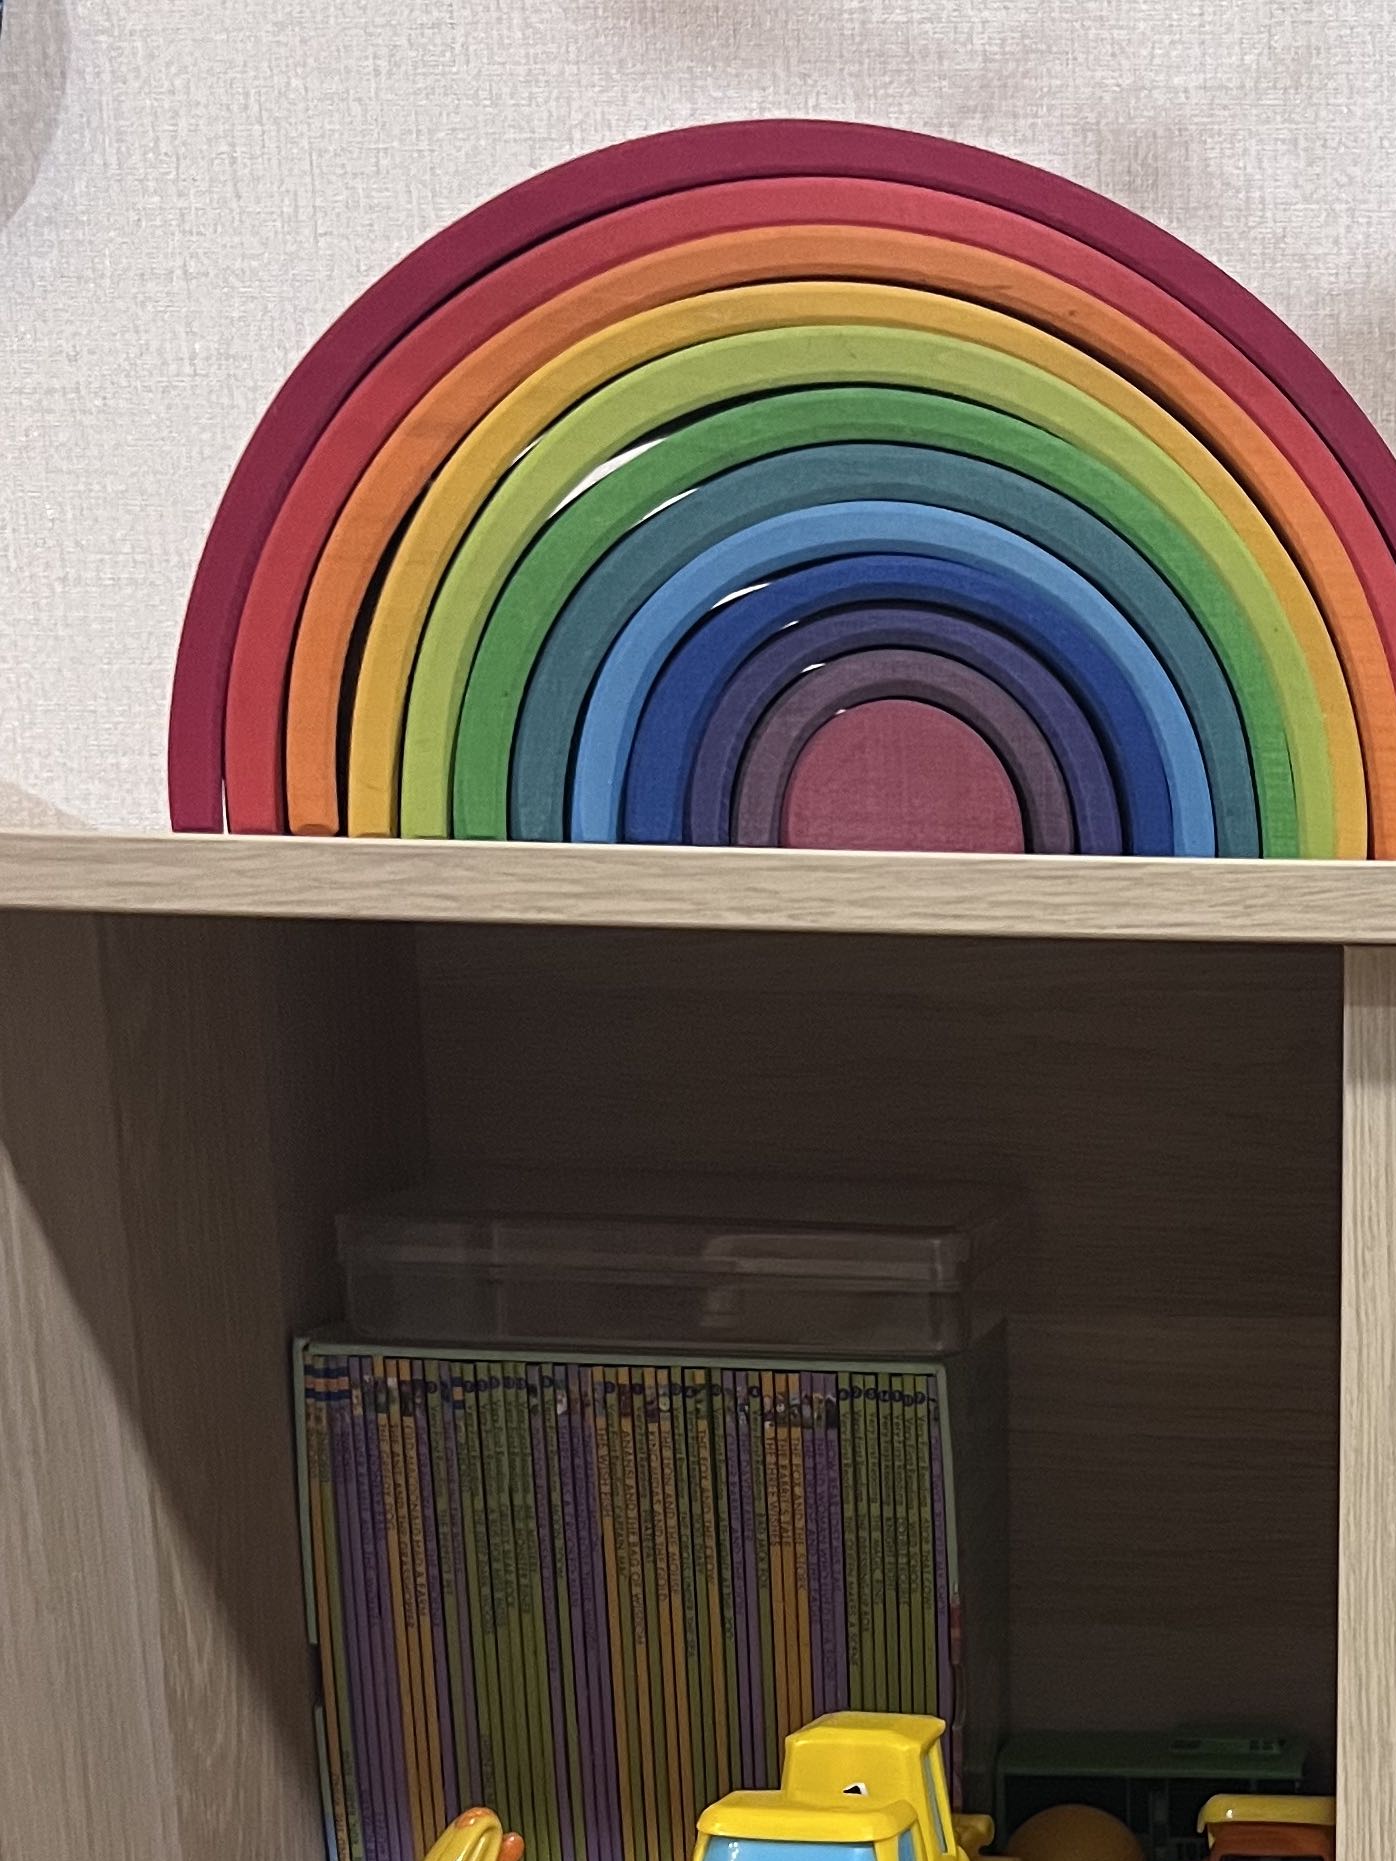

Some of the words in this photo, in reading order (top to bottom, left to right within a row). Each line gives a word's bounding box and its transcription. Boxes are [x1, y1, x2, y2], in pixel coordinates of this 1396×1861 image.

[389, 1424, 400, 1446] THE
[596, 1425, 607, 1449] THE
[661, 1429, 671, 1453] THE
[697, 1429, 707, 1452] THE
[621, 1430, 633, 1479] ANANSI
[765, 1437, 775, 1460] THE
[777, 1437, 786, 1459] THE
[790, 1438, 800, 1459] THE
[598, 1454, 609, 1486] WISH
[699, 1457, 709, 1480] FOX
[791, 1463, 801, 1488] FOX
[767, 1466, 777, 1500] THREE
[600, 1491, 611, 1517] FISH
[624, 1482, 635, 1512] AND
[665, 1490, 675, 1519] AND
[793, 1494, 803, 1521] AND
[627, 1515, 637, 1536] THE
[653, 1510, 663, 1538] AND
[667, 1525, 676, 1547] THE
[703, 1519, 712, 1541] THE
[769, 1501, 779, 1547] WISHES
[781, 1520, 790, 1546] TALE
[794, 1526, 804, 1547] THE
[629, 1541, 639, 1567] BAG
[655, 1542, 665, 1563] THE
[705, 1546, 714, 1582] CROW
[631, 1571, 640, 1587] OF
[657, 1567, 667, 1601] GOLD
[669, 1552, 679, 1594] MOUSE
[796, 1552, 806, 1591] STORK
